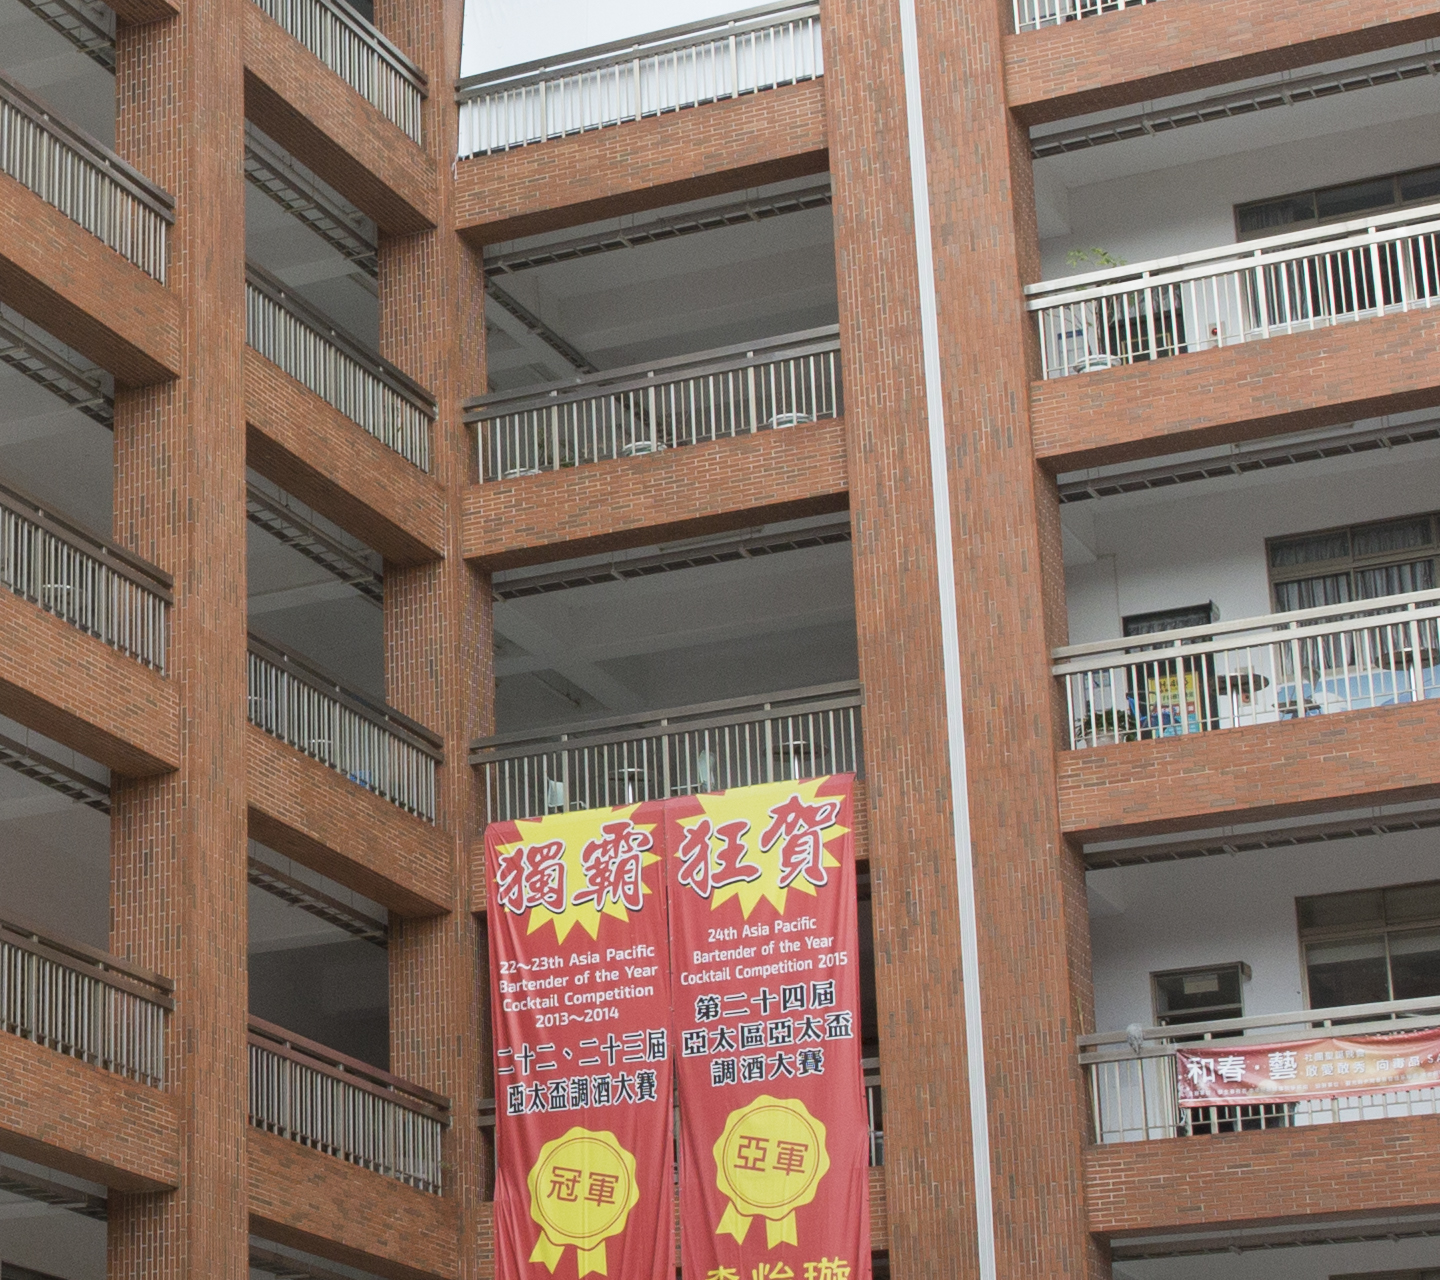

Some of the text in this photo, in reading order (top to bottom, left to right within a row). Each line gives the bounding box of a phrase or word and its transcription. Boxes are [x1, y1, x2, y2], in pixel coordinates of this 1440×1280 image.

[678, 793, 841, 899] 狂賀
[708, 916, 817, 943] 24th Asia Pacific
[569, 951, 600, 967] Asia
[606, 944, 656, 962] Pacific
[680, 951, 848, 986] Cocktail Competition 2015
[693, 936, 834, 965] Bartender of the Year
[499, 965, 659, 993] Bartender of the Year
[503, 985, 655, 1012] Cocktail Competition
[682, 1011, 853, 1057] 亞太區亞太盃
[711, 1047, 825, 1088] 調酒大賽
[507, 1069, 657, 1116] 亞太盃調酒大賽
[734, 1134, 810, 1177] 亞軍
[547, 1166, 619, 1208] 冠軍
